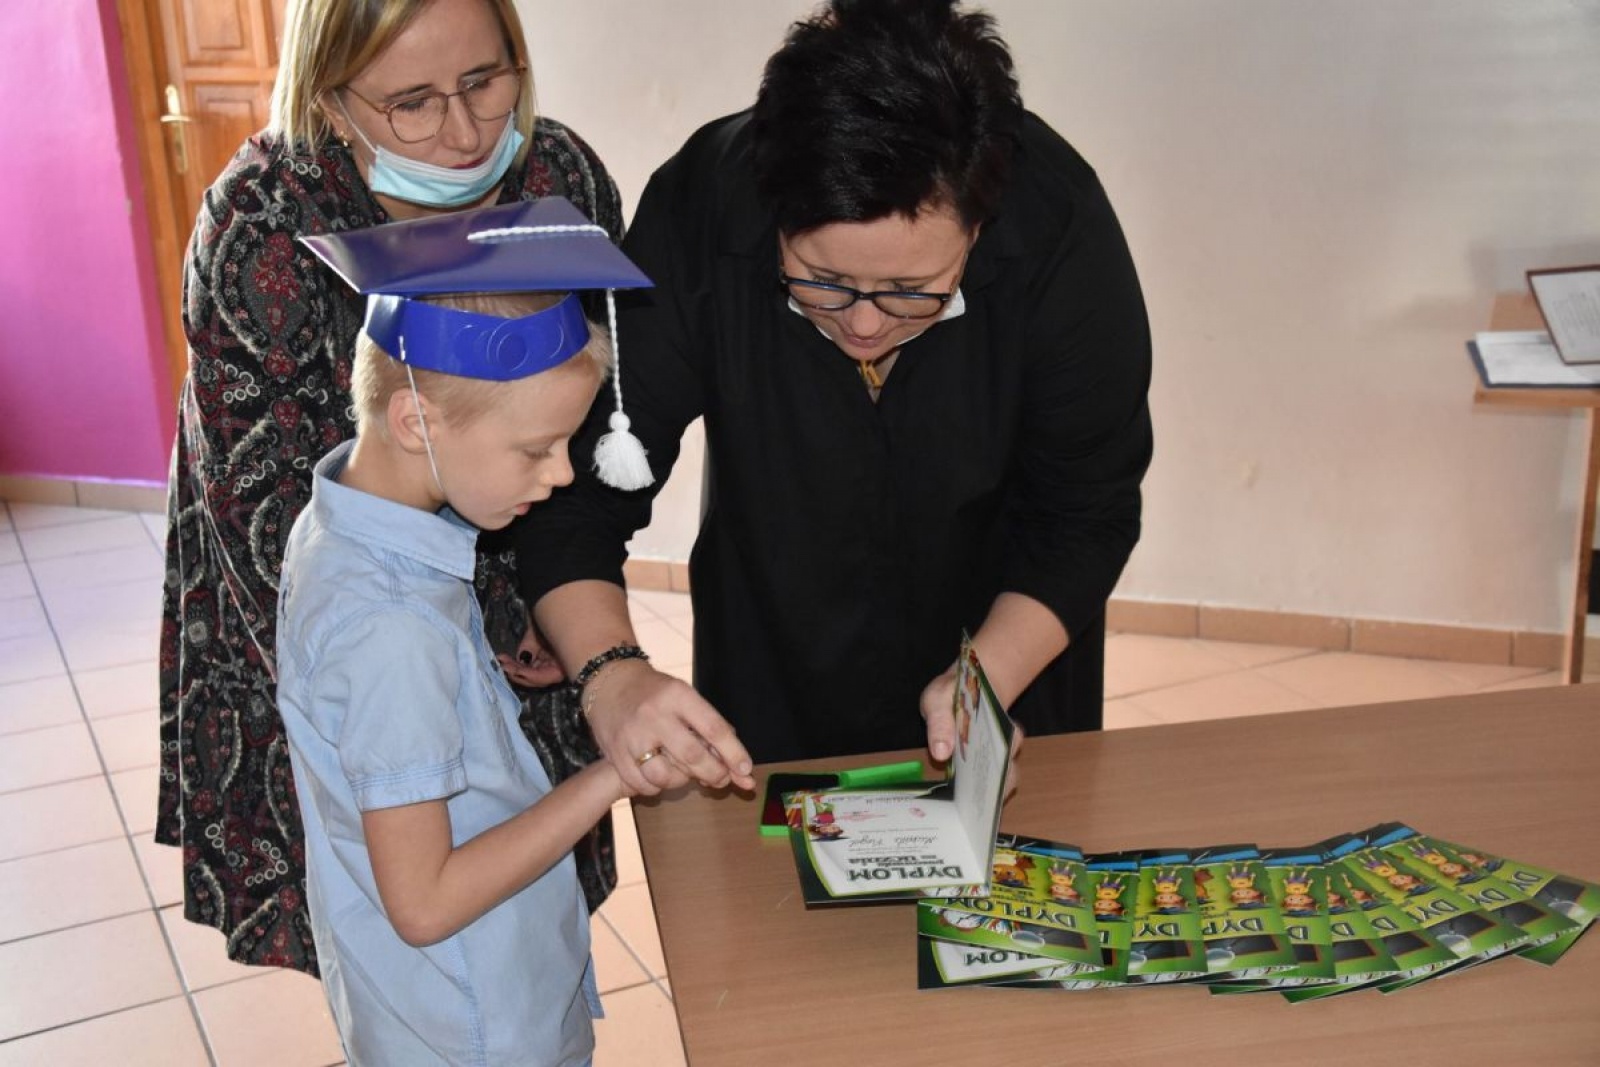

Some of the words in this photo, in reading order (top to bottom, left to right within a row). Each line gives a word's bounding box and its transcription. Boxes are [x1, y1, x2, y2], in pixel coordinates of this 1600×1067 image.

[847, 866, 963, 880] DYPLOM
[946, 898, 1077, 928] DYPLOM
[1203, 917, 1264, 935] DYP
